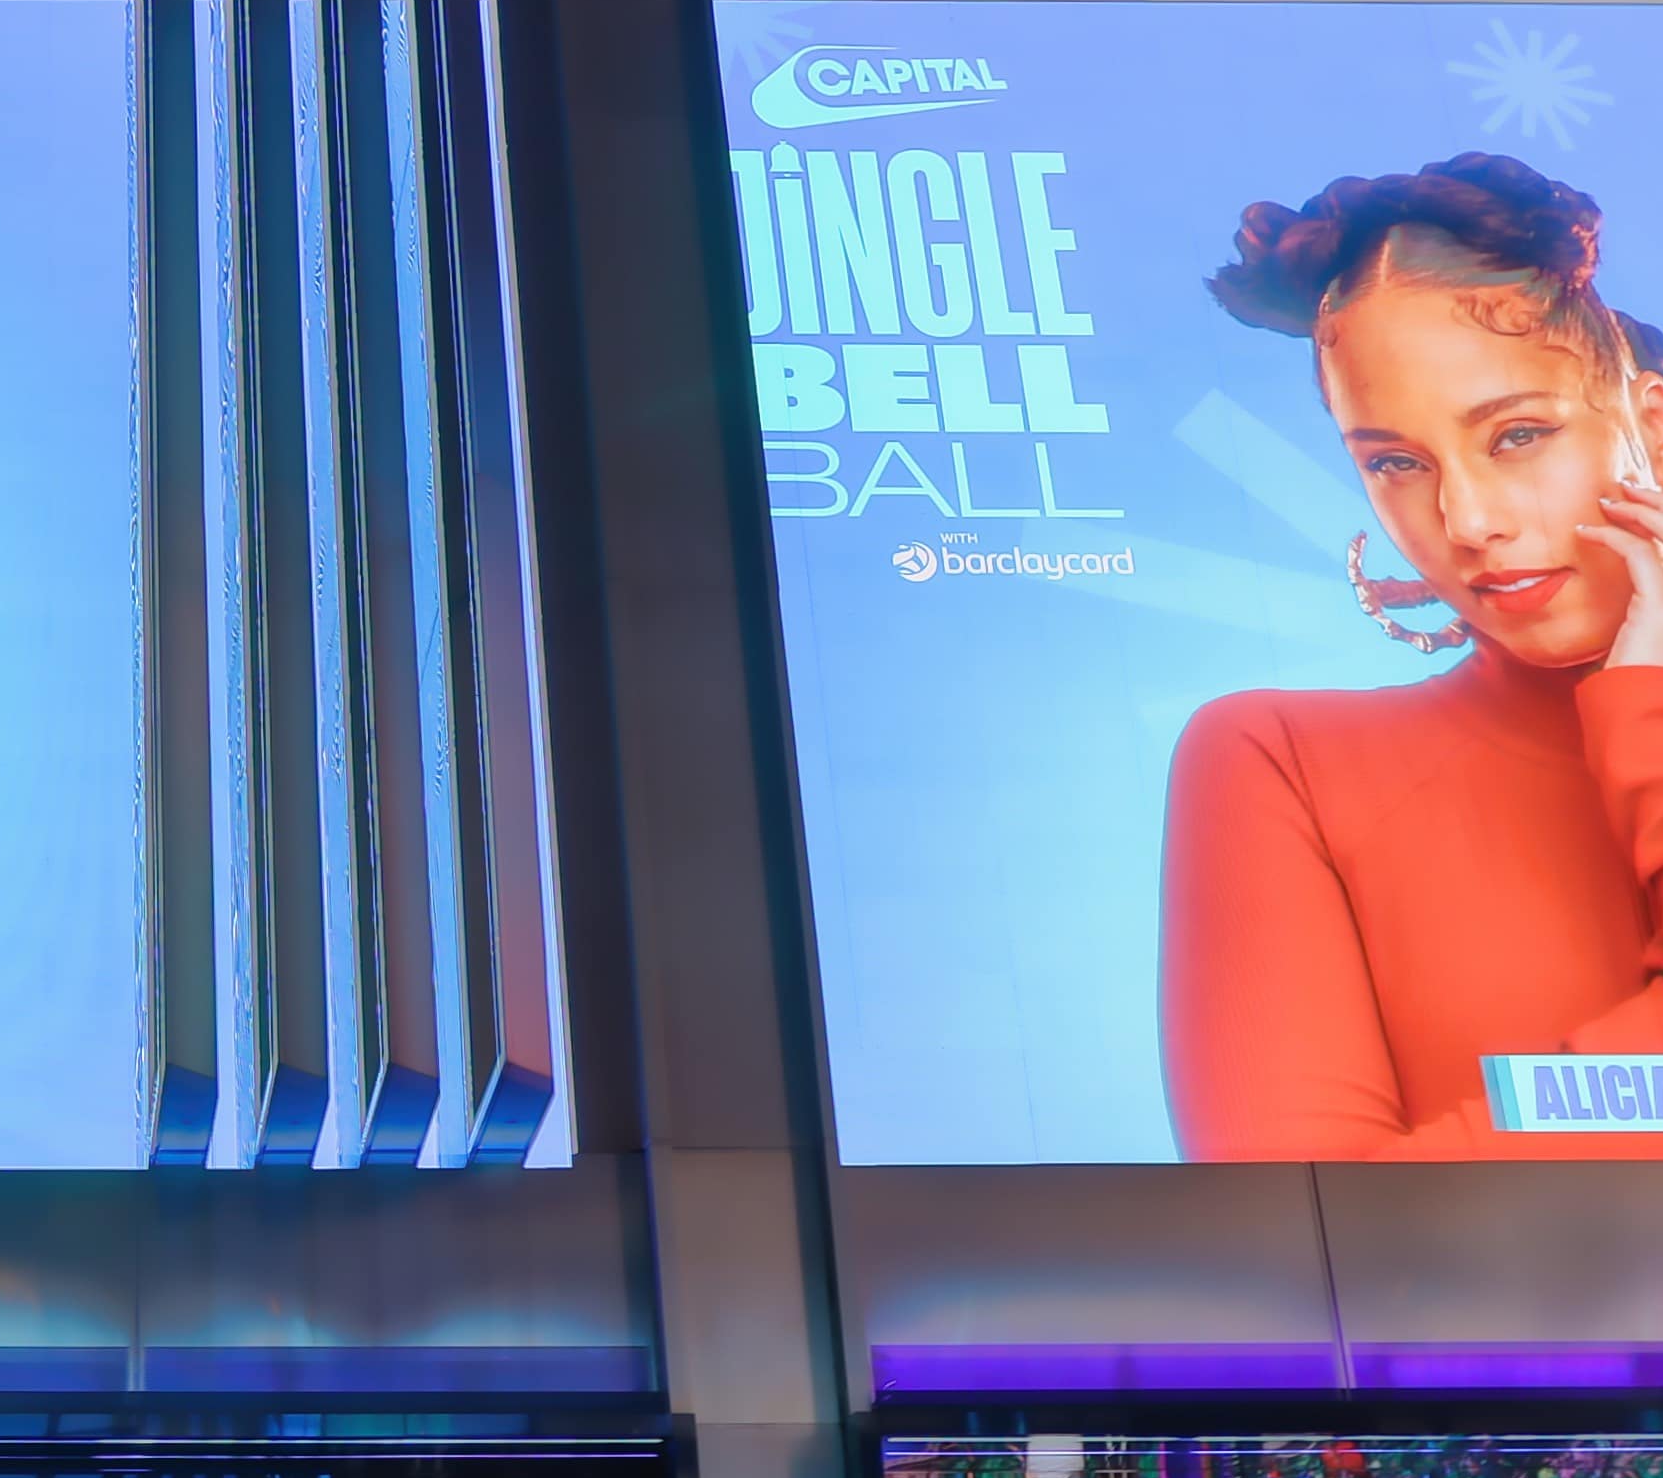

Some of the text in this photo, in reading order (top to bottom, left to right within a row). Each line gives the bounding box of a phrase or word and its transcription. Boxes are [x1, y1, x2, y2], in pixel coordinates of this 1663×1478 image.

[807, 58, 1008, 96] CAPITAL
[751, 344, 1110, 433] BELL
[762, 441, 1125, 518] BALL
[940, 533, 978, 544] WITH
[942, 546, 1134, 580] barclaycard
